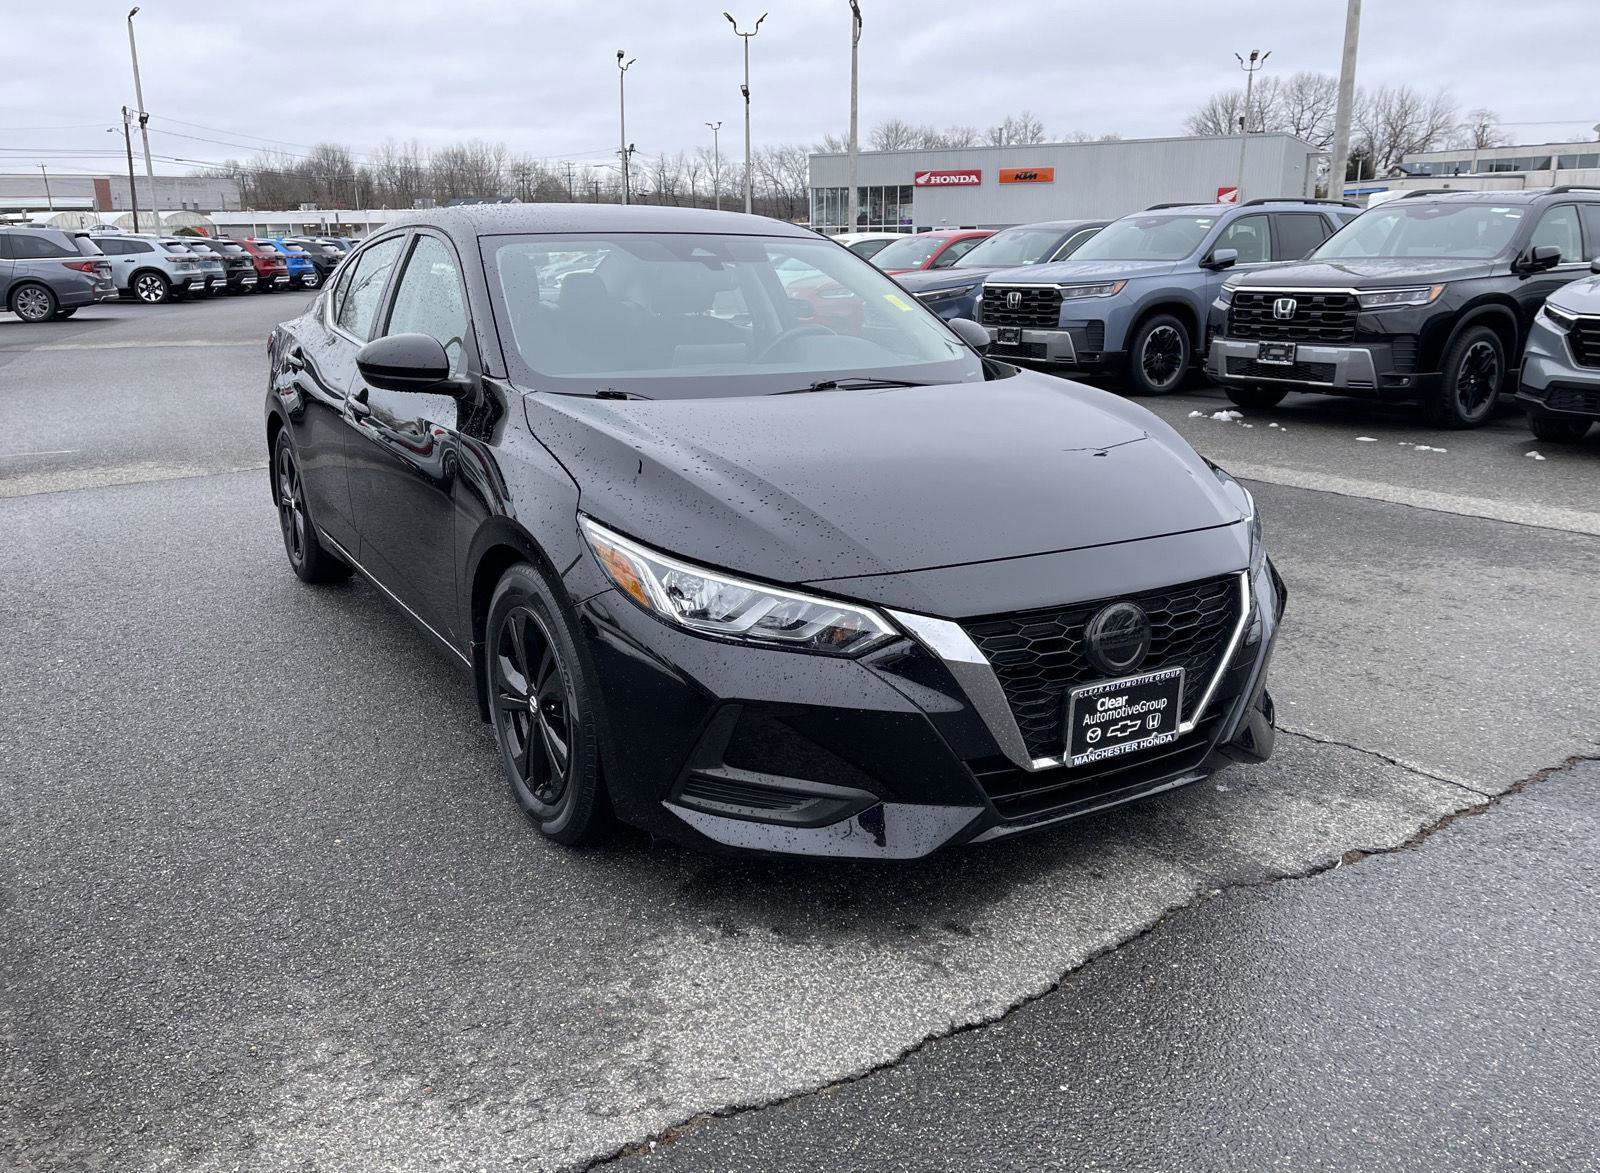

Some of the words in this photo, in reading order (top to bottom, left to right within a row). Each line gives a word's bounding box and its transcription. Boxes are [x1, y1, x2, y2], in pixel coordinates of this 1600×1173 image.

[930, 174, 979, 184] HONDA
[1014, 171, 1038, 181] KTM
[1079, 686, 1104, 698] CLEAR
[1105, 676, 1153, 692] AUTOMOTIVE
[1155, 670, 1180, 681] GROUP
[1082, 697, 1167, 726] AutomotiveGroup
[1097, 695, 1128, 711] Clear
[1074, 742, 1138, 766] MANCHESTER
[1140, 734, 1173, 749] HONDA
